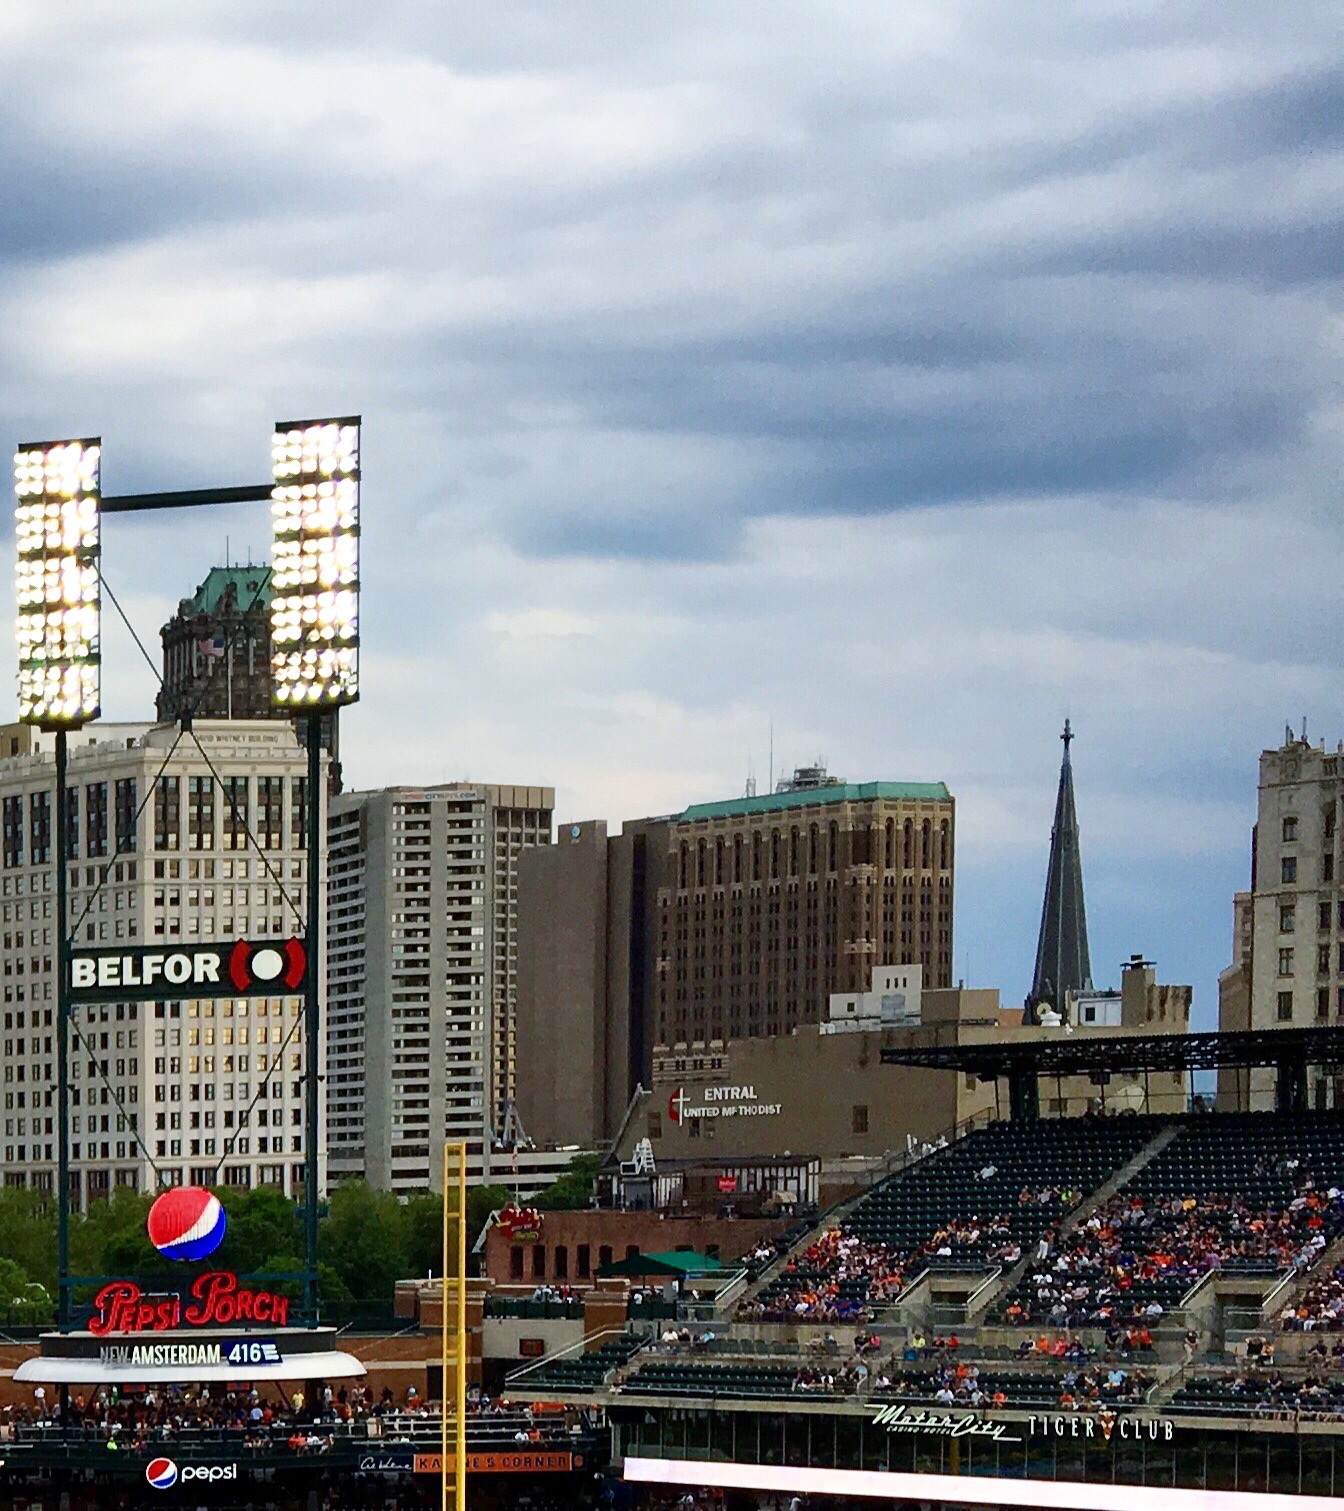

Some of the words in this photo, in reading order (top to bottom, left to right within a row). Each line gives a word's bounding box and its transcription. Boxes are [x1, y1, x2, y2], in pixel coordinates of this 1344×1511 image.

[71, 952, 221, 988] BELFOR
[683, 1107, 720, 1118] UNITED
[131, 1344, 221, 1365] AMSTERDAM
[228, 1343, 261, 1364] 416
[1028, 1415, 1095, 1438] TIGER
[1120, 1418, 1174, 1441] CLUB
[181, 1462, 238, 1483] pepsi
[502, 1456, 567, 1468] CORNER
